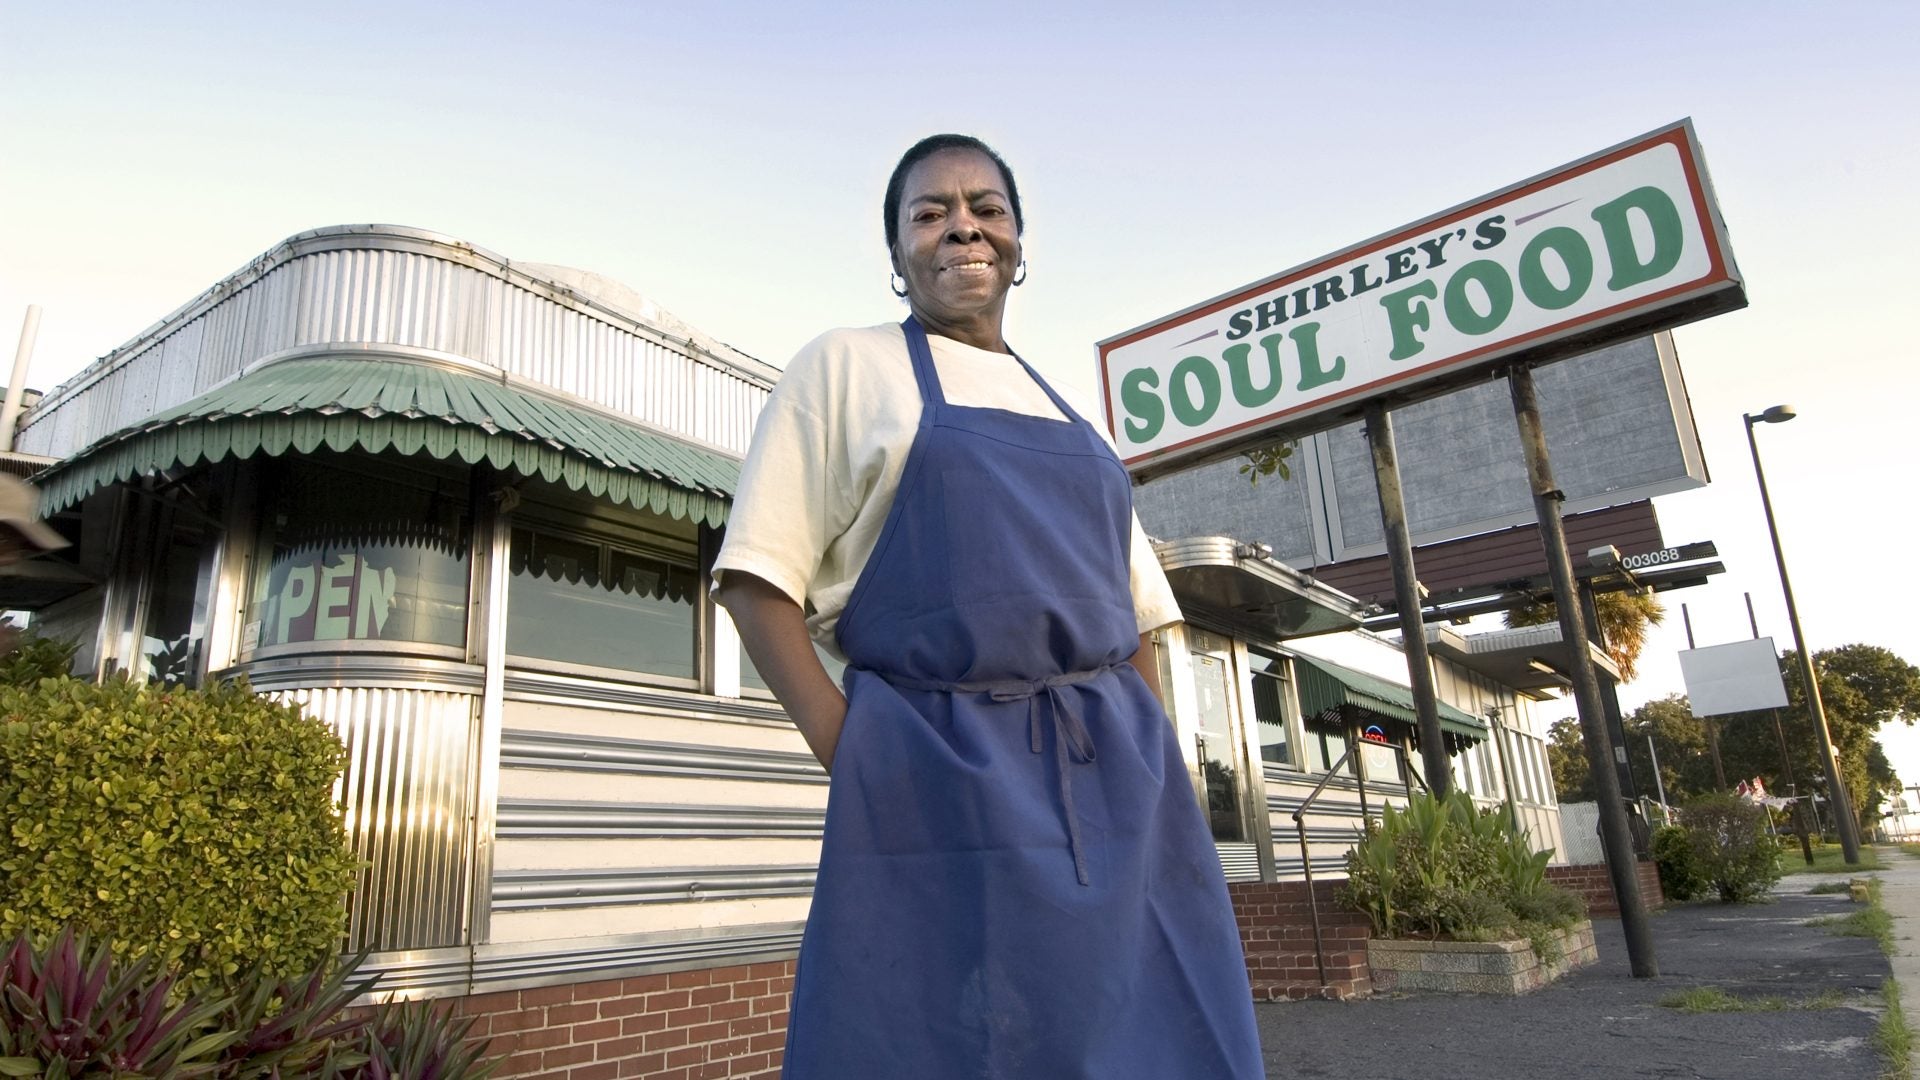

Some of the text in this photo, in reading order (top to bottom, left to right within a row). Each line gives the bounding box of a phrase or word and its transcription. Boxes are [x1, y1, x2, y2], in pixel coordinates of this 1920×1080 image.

[1120, 185, 1684, 444] SOUL FOOD
[1226, 215, 1506, 340] SHIRLEY'S
[268, 554, 397, 644] PEN
[1622, 548, 1680, 569] 003088
